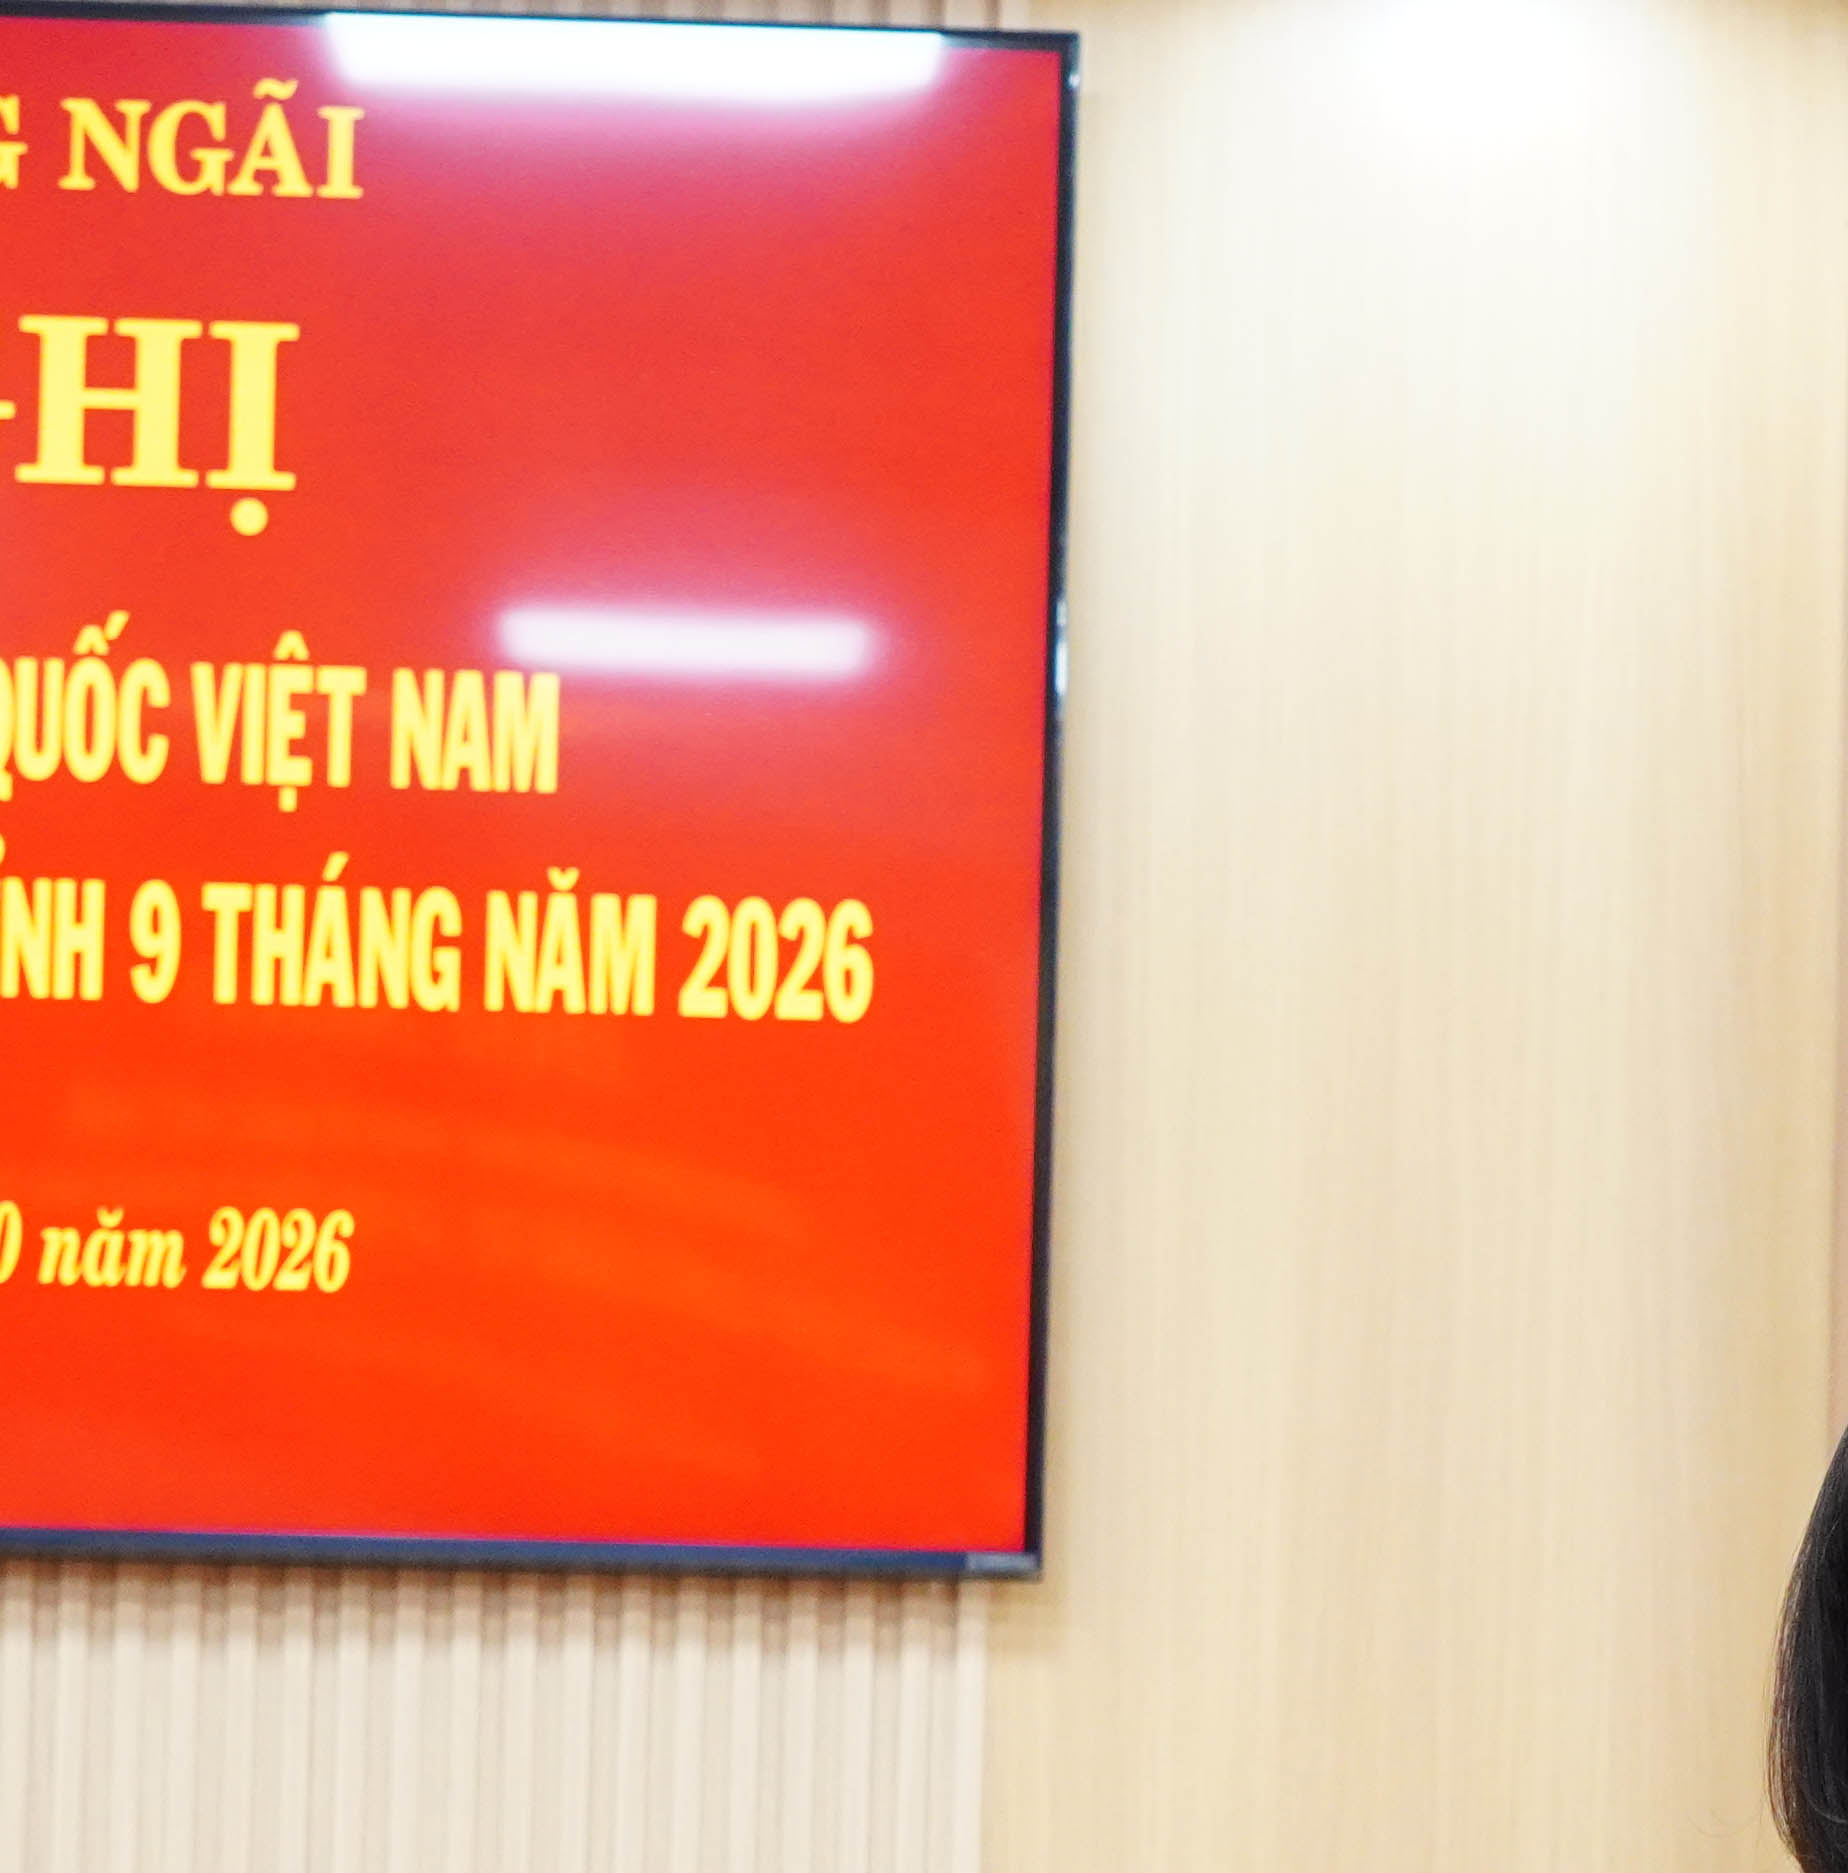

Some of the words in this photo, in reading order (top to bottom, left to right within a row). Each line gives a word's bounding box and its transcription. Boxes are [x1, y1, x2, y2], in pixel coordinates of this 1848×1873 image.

[59, 80, 361, 198] NGÃI
[190, 630, 367, 812] VIỆT
[390, 668, 558, 794] NAM
[130, 879, 181, 1003] 9
[202, 850, 462, 1012] THÁNG
[486, 866, 657, 1016] NĂM
[678, 895, 874, 1023] 2026
[38, 1208, 186, 1288] năm
[202, 1206, 355, 1293] 2026
